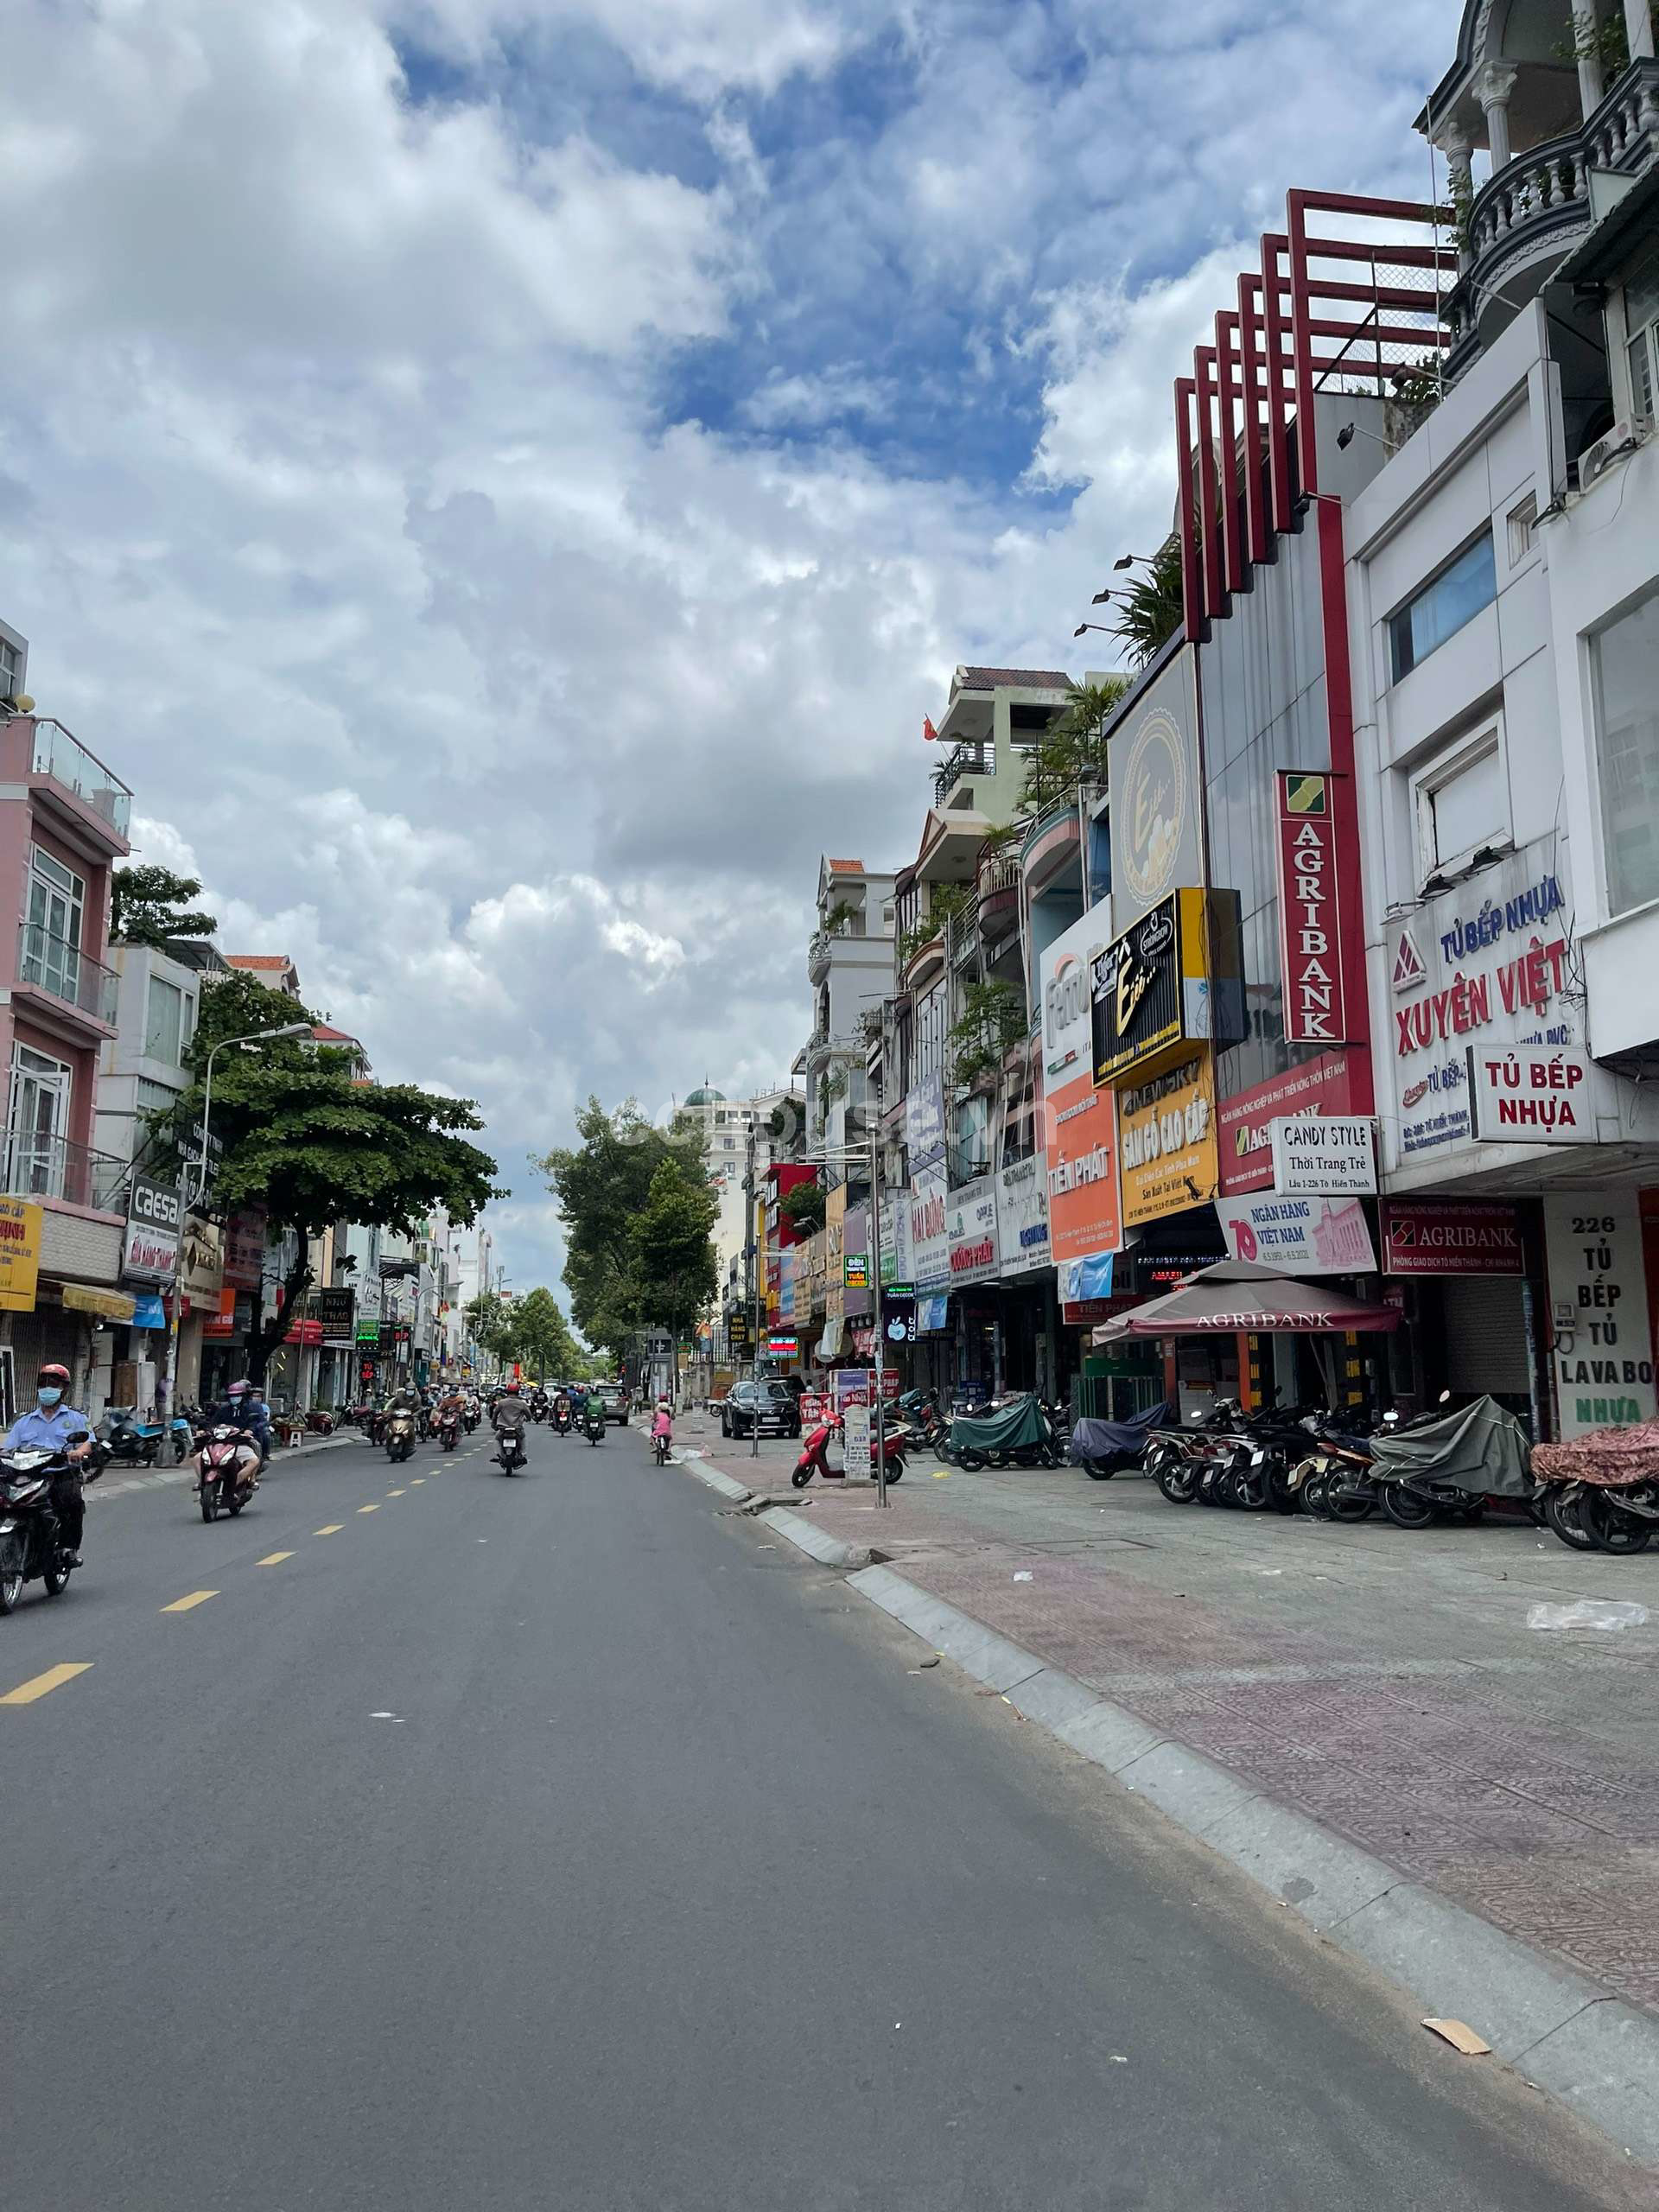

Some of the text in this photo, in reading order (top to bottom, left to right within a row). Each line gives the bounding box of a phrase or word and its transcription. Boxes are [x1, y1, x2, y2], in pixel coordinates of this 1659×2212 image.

[1294, 823, 1335, 1038] AGRIBANK
[1440, 874, 1565, 963] TỦ BẾP NHỰA
[1396, 936, 1569, 1057] XUYÊN VIỆT
[1485, 1053, 1583, 1090] TỦ BẾP
[1499, 1096, 1577, 1133] NHỰA
[1284, 1126, 1367, 1147] CANDY STYLE
[1047, 1141, 1110, 1197] TIẾN PHÁT
[1288, 1155, 1366, 1173] Thời Trang Trẻ
[1303, 1179, 1319, 1188] 1-226
[1320, 1179, 1329, 1188] Tô
[1332, 1179, 1349, 1188] Hiến
[1251, 1200, 1310, 1224] NGÂN HÀNG
[1257, 1226, 1305, 1247] VIỆT NAM
[1420, 1226, 1518, 1248] AGRIBANK
[1572, 1217, 1616, 1234] 226
[1392, 1255, 1413, 1268] PHÒNG
[1413, 1256, 1427, 1268] GIAO
[1427, 1256, 1441, 1269] DỊCH
[1583, 1237, 1611, 1271] TỦ
[1578, 1274, 1622, 1308] BẾP
[1196, 1313, 1335, 1328] AGRIBANK
[1588, 1313, 1618, 1346] TỦ
[1560, 1360, 1653, 1384] LAVABO
